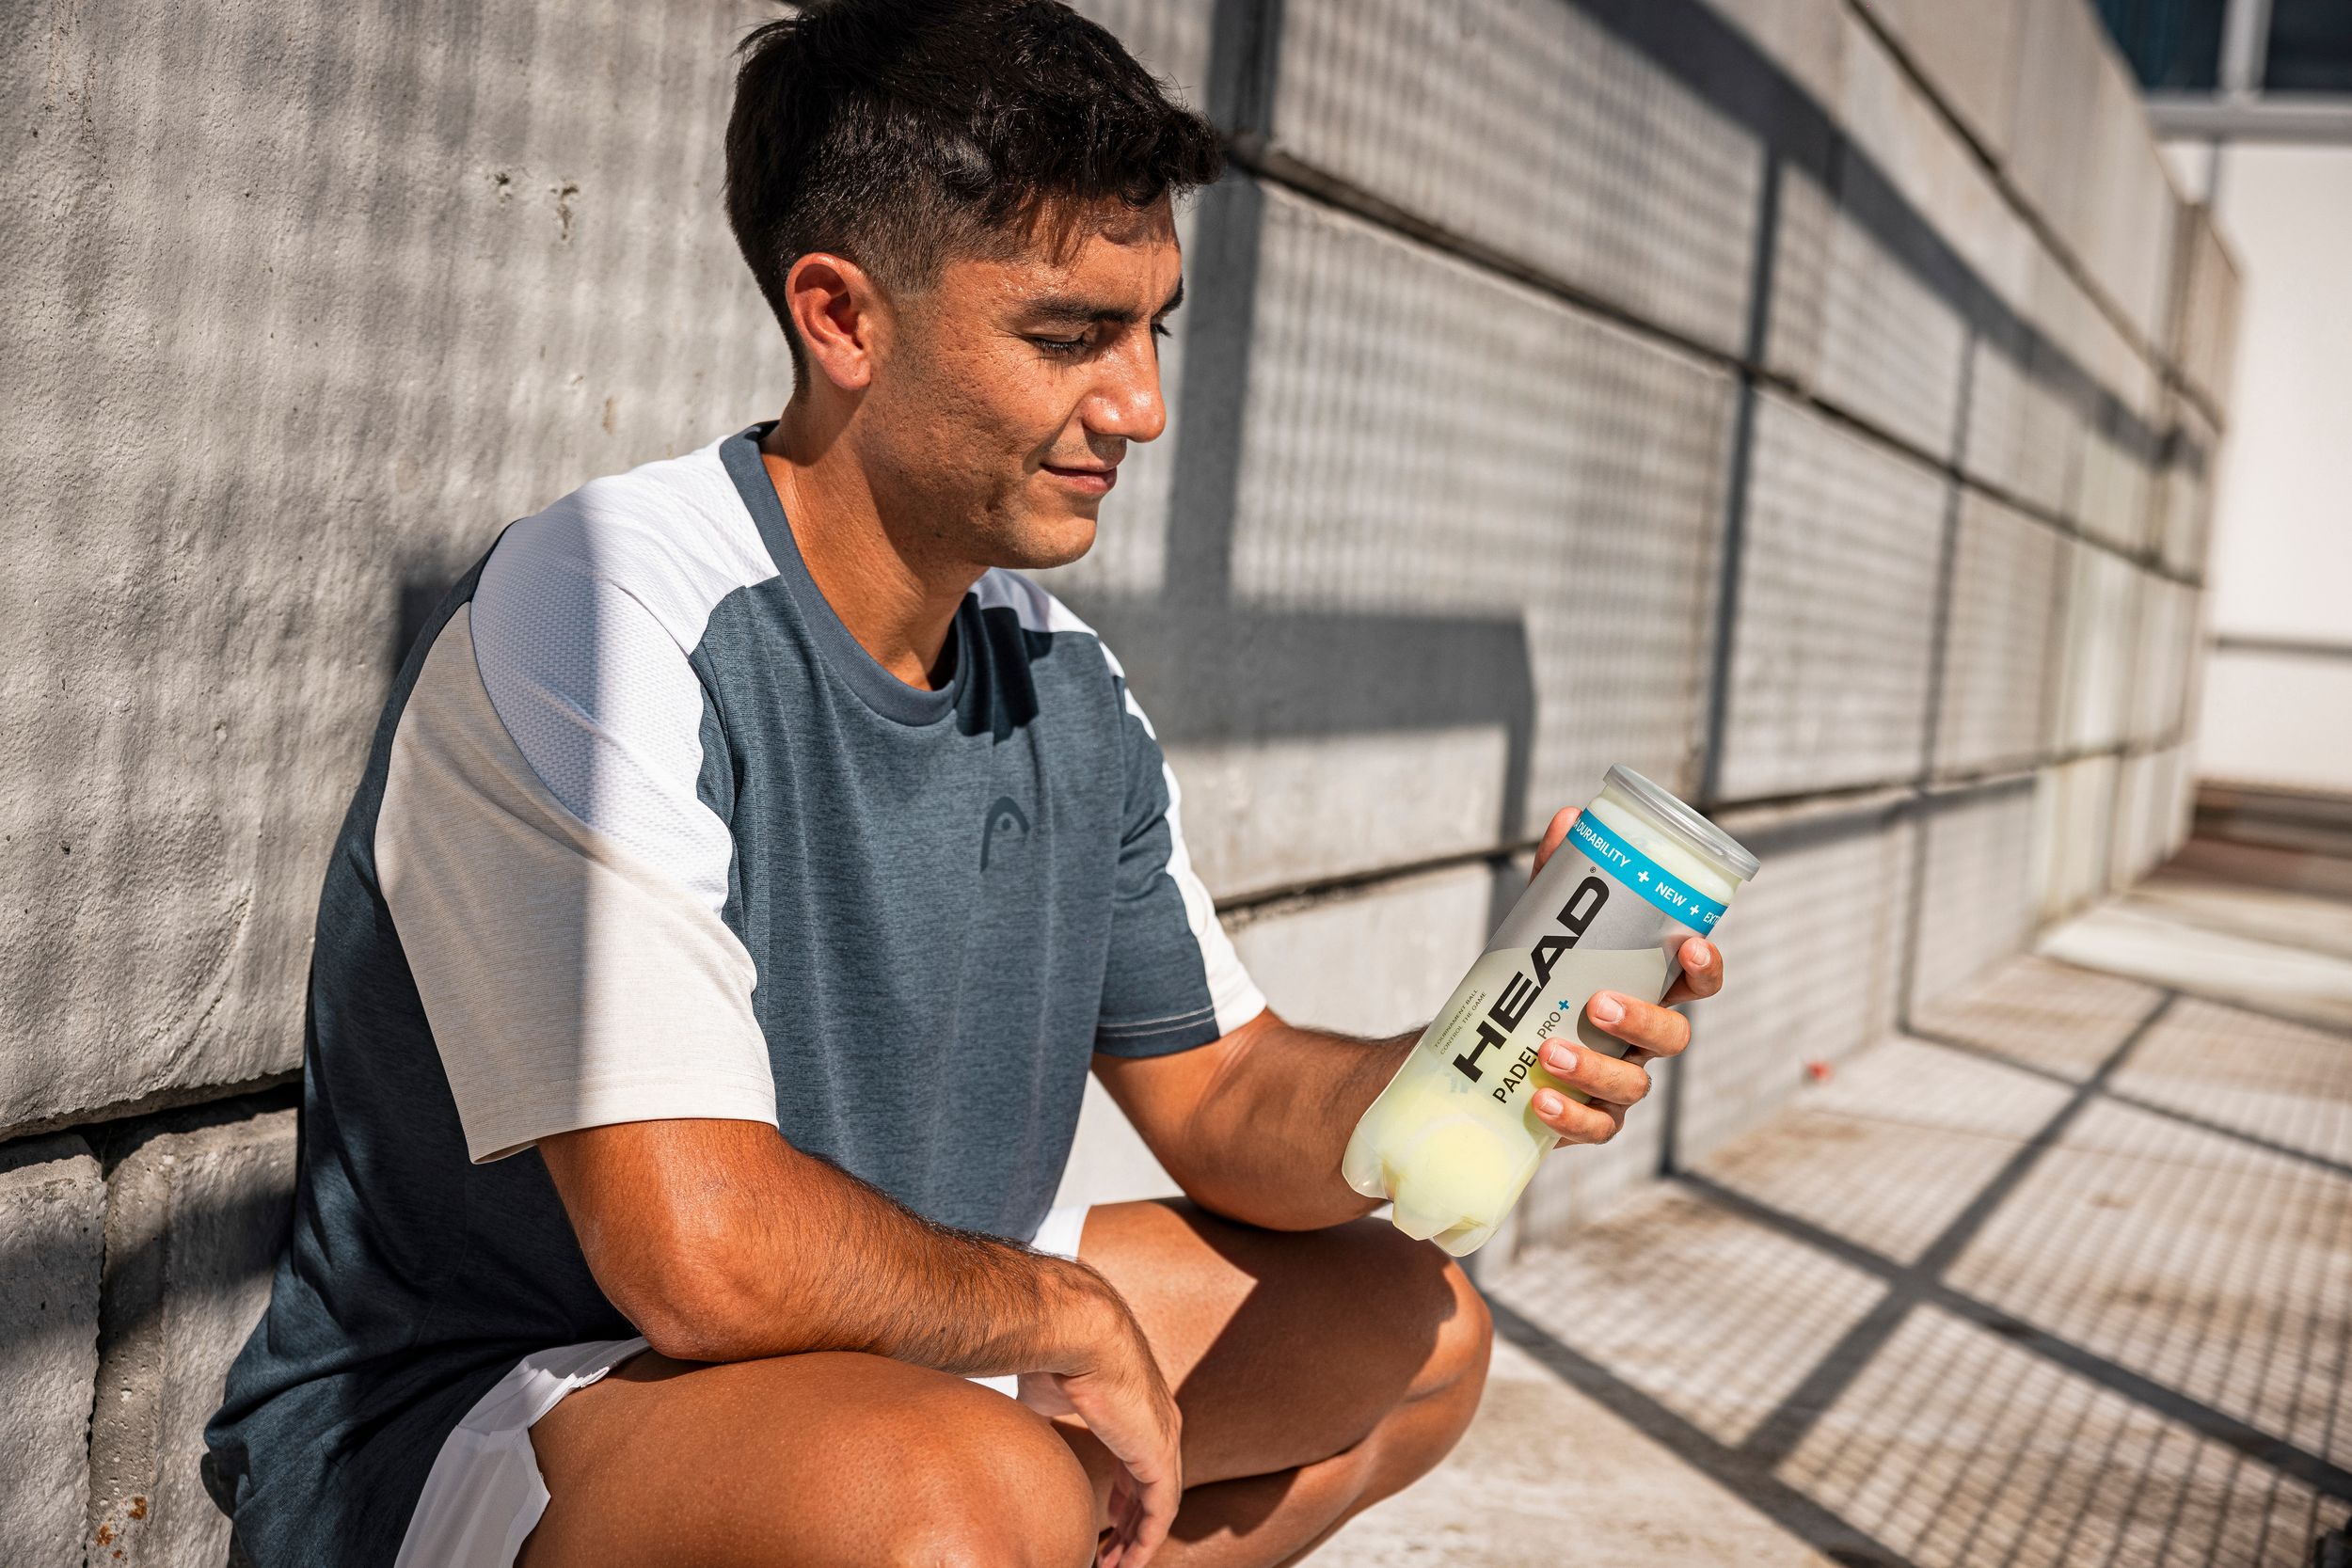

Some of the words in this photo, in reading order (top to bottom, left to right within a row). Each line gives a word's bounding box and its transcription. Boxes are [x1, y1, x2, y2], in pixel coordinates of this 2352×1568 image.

[1577, 821, 1631, 868] DURABILITY
[1654, 881, 1688, 907] NEW
[1434, 1005, 1466, 1049] TOURNAMENT
[1465, 988, 1479, 1006] BALL
[1440, 1024, 1463, 1055] CONTROL
[1462, 1010, 1473, 1024] THE
[1471, 991, 1487, 1011] GAME
